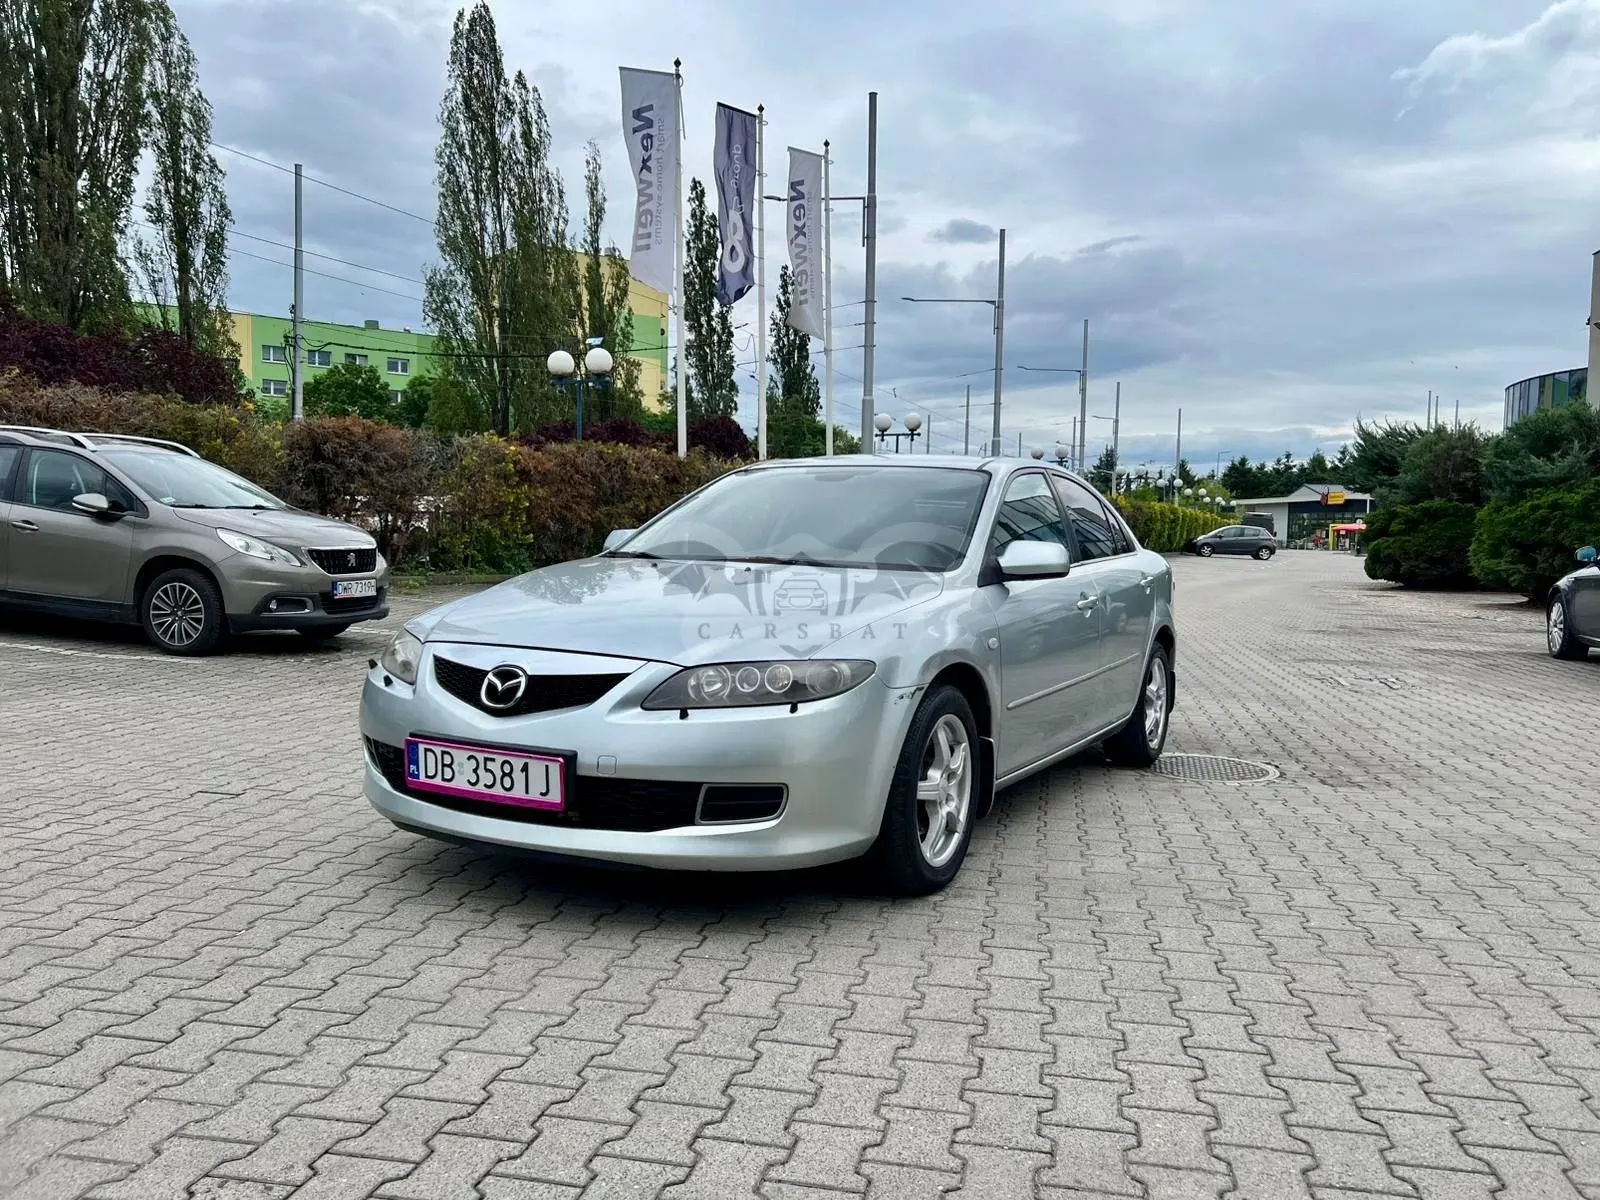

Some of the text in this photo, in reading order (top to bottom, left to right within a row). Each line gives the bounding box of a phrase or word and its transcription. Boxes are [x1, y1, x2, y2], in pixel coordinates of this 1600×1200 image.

[338, 583, 353, 595] DWR
[423, 747, 550, 797] DB 3581J
